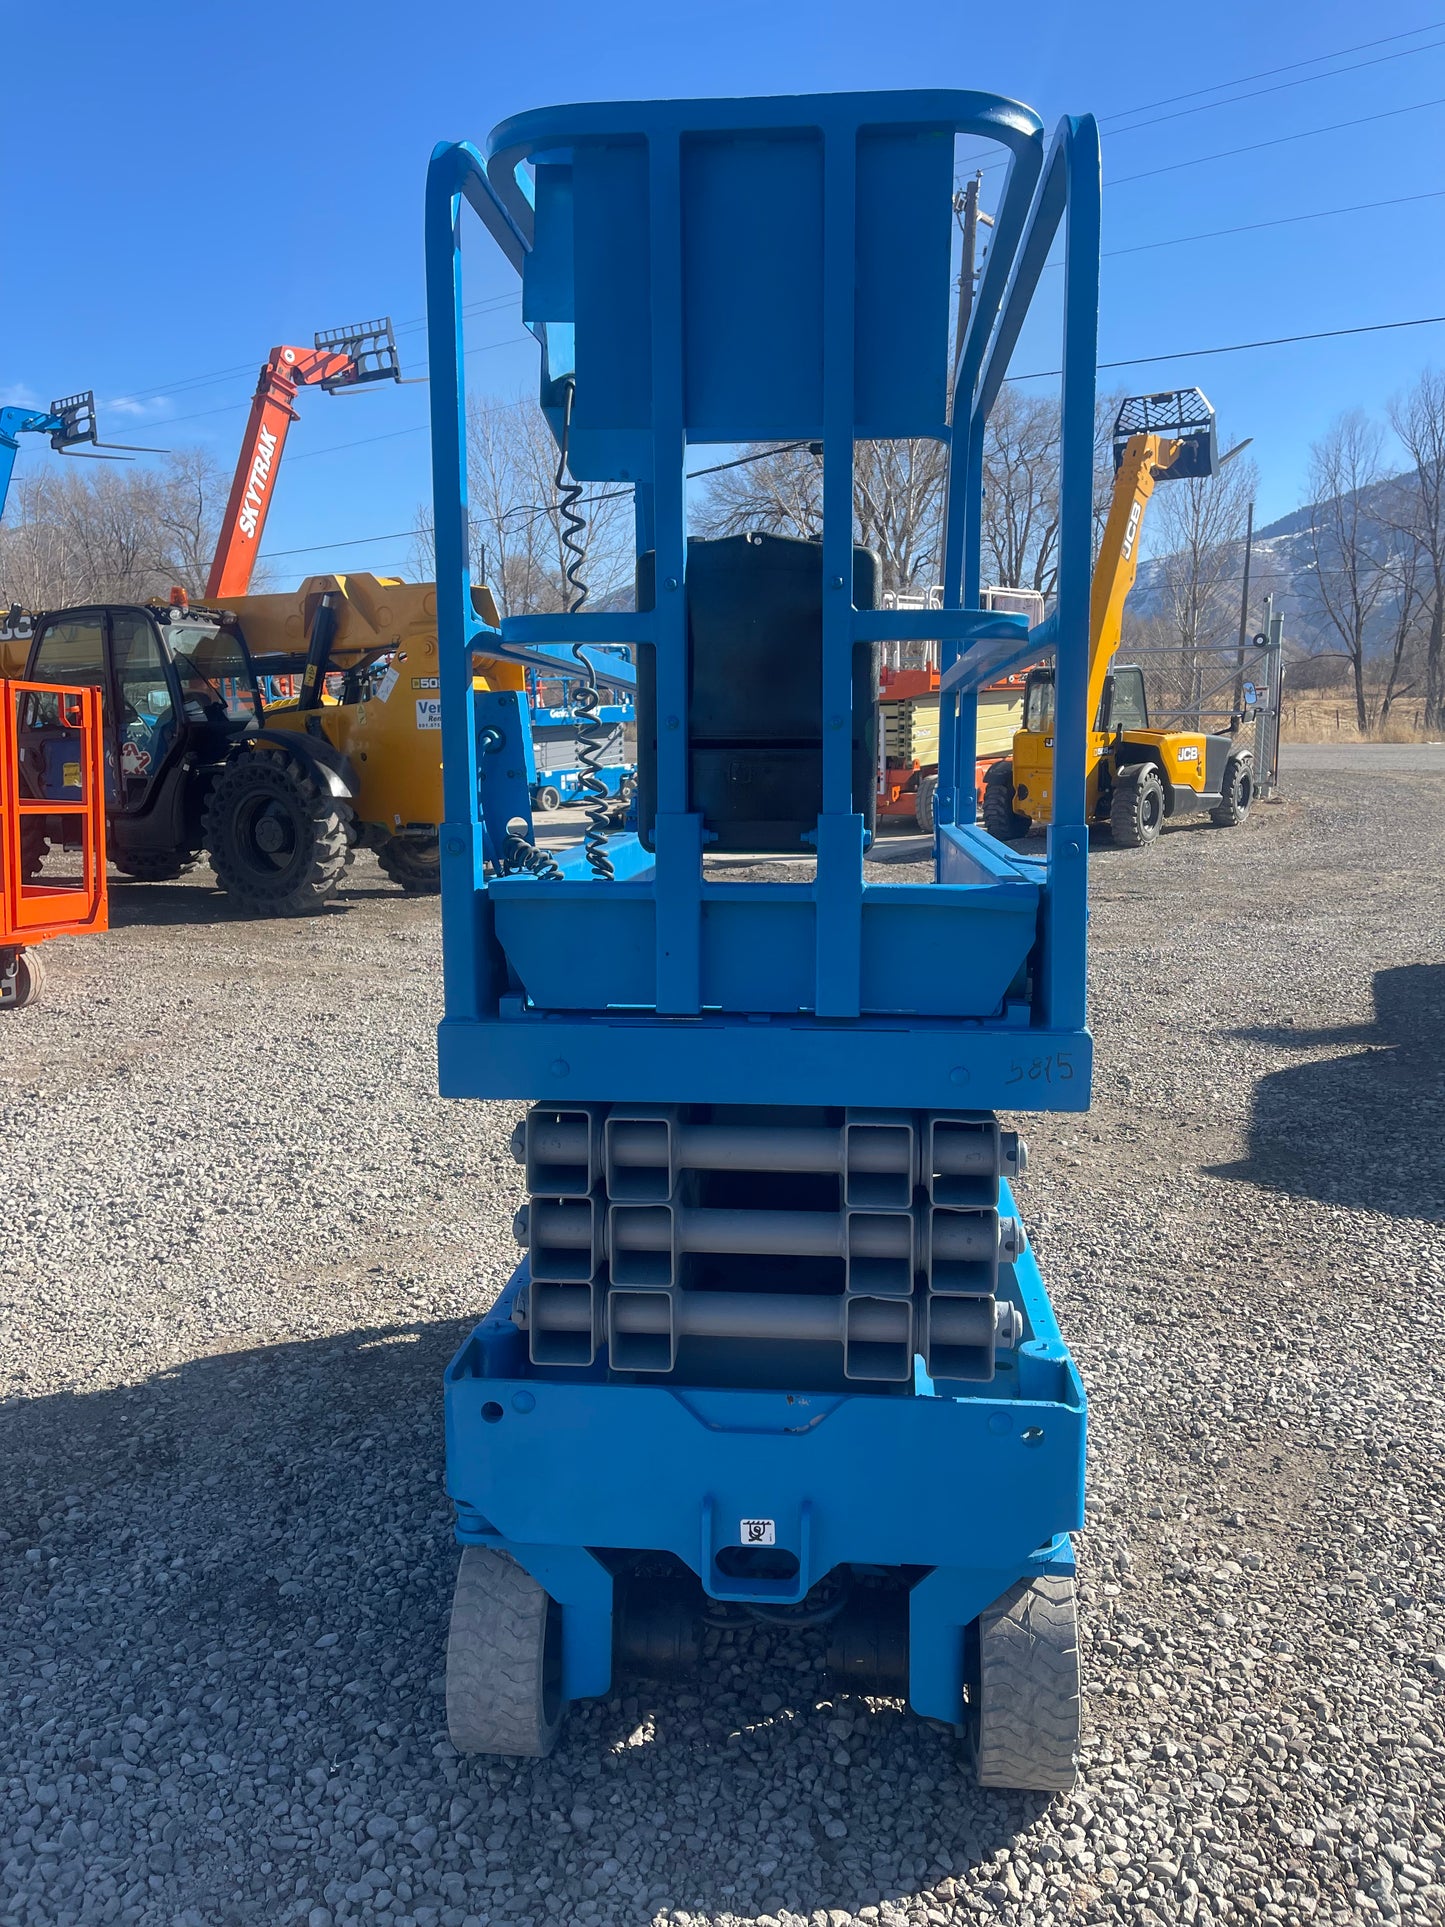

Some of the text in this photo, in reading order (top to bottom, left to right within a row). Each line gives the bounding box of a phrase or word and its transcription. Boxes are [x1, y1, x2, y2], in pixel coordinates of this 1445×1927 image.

[240, 423, 278, 539] SKYTRAK
[1123, 501, 1142, 560] JCB
[1178, 747, 1198, 760] JCB
